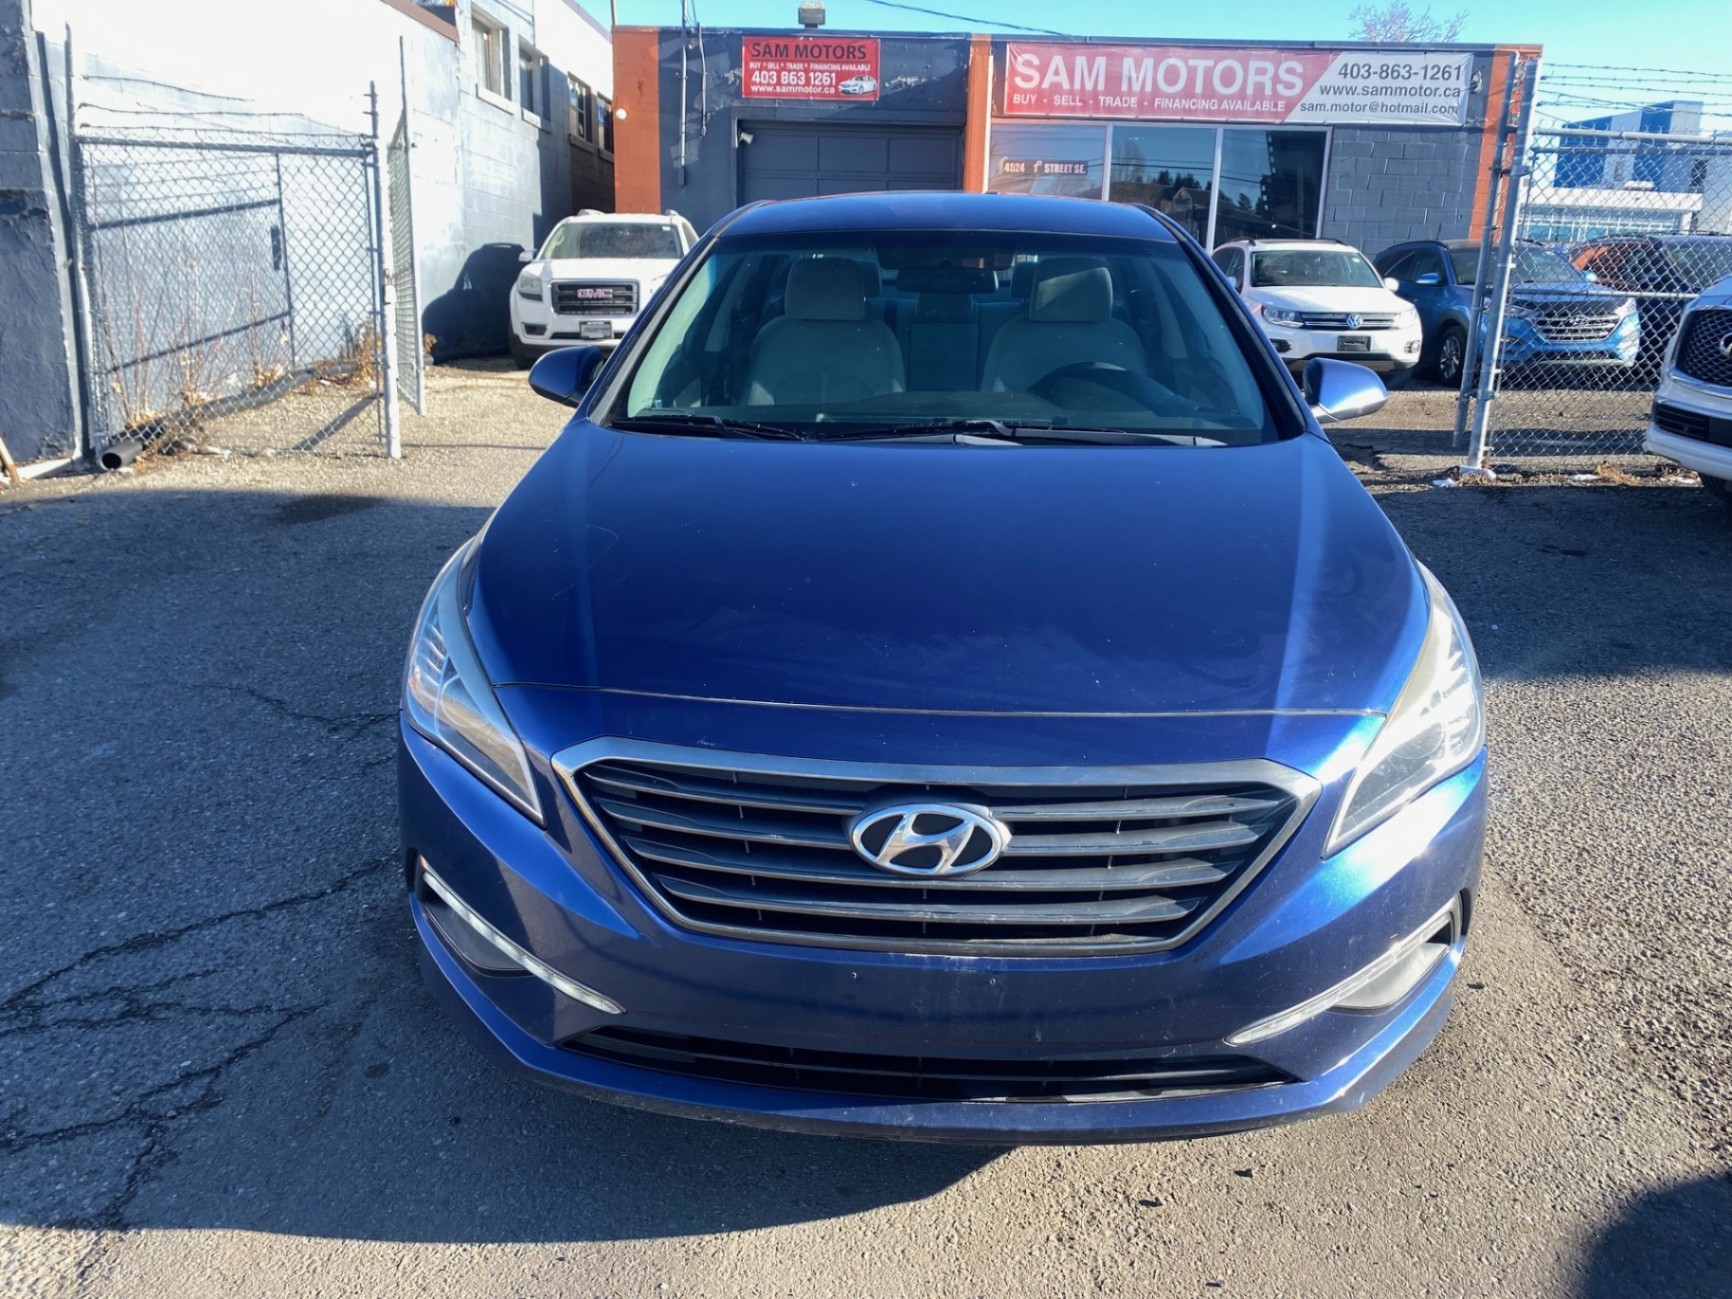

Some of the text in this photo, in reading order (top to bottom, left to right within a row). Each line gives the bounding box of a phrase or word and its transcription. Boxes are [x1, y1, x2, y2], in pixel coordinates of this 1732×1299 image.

[751, 43, 867, 60] SAM MOTORS
[751, 70, 836, 86] 403 863 1261
[1013, 53, 1304, 97] SAM MOTORS
[1338, 62, 1463, 81] 403-863-1261
[750, 83, 836, 95] www.sammotor.ca
[1319, 84, 1462, 98] www.sammotor.ca
[1012, 93, 1286, 112] BUY SELL TRADE FINANCING AVAILABLE
[1299, 101, 1459, 115] sam.motor@hotmail.com
[1003, 162, 1026, 173] 4524
[1044, 163, 1073, 174] STREET
[577, 288, 613, 299] GMC
